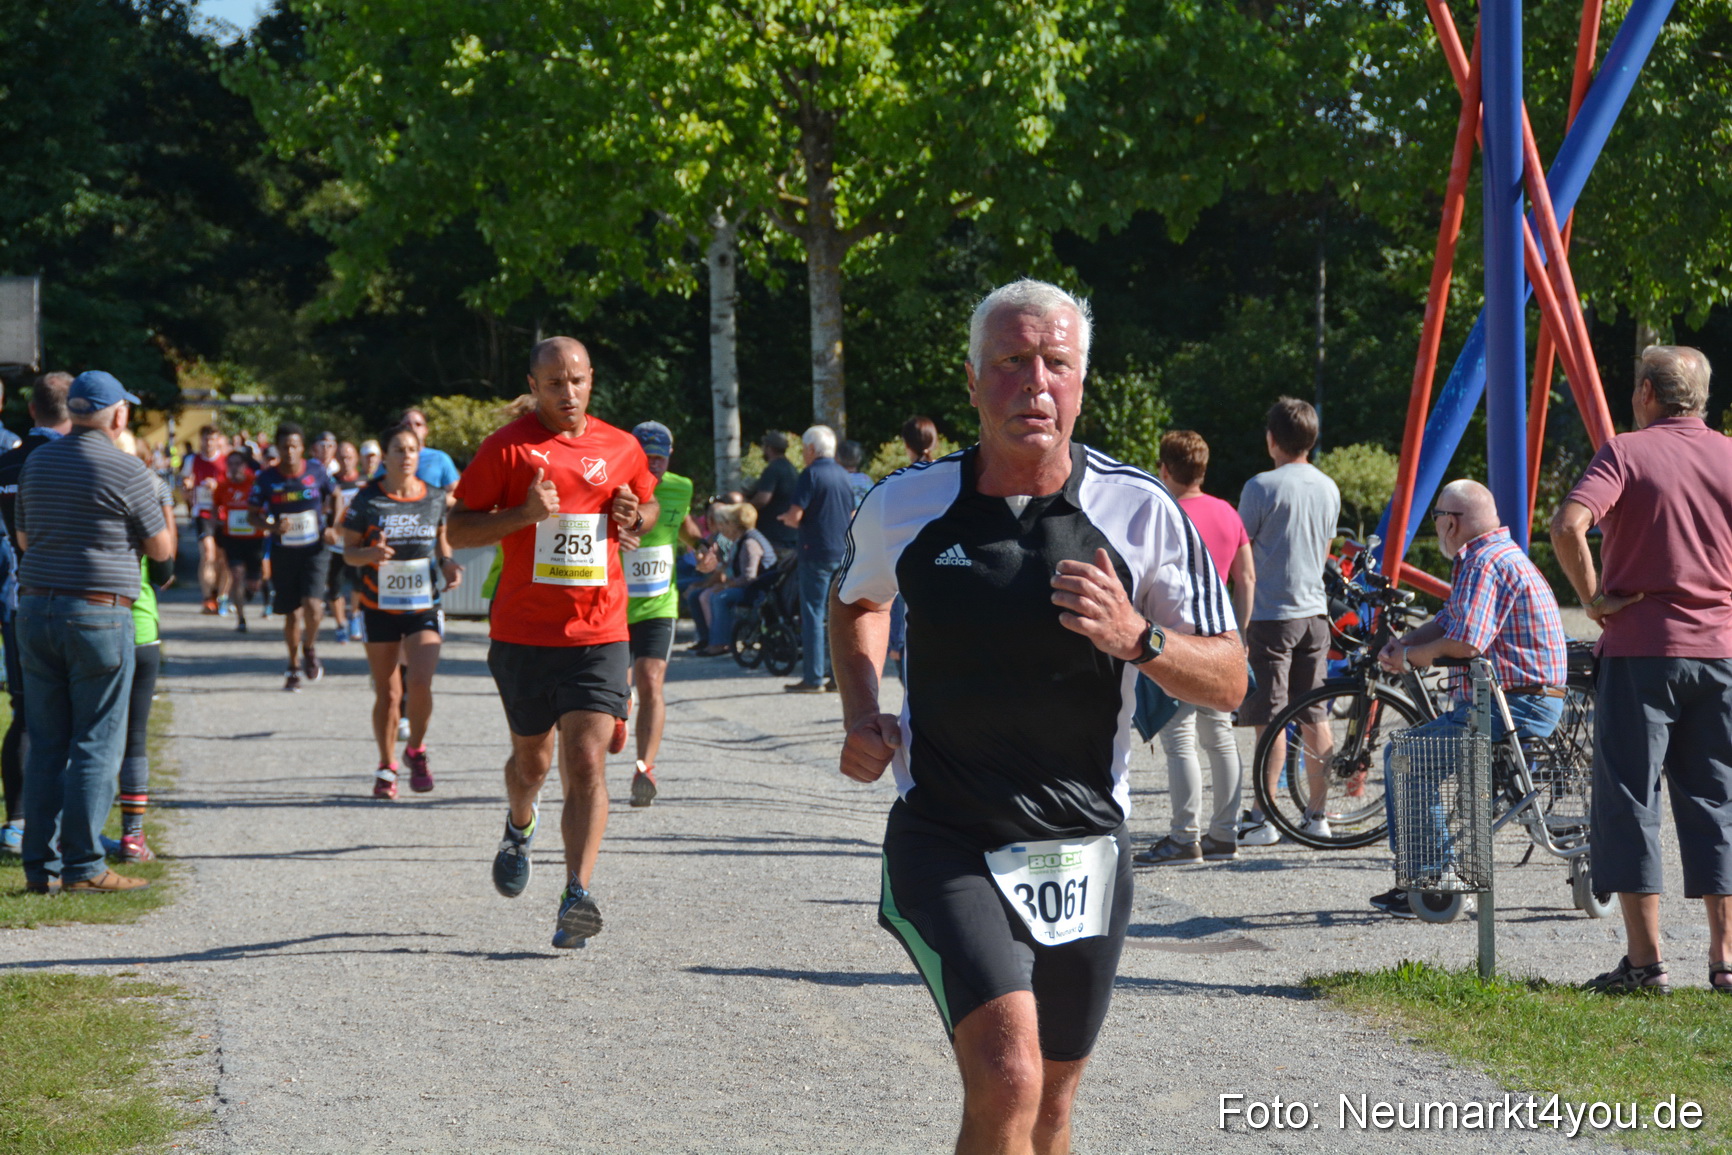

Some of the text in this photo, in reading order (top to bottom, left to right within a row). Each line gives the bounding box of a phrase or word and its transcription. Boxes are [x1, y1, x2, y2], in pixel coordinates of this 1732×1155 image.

[378, 513, 420, 527] HECK
[559, 520, 590, 528] BOCK
[383, 525, 437, 538] DESIGN
[553, 533, 592, 555] 253
[632, 559, 667, 576] 3070
[935, 556, 972, 566] adidas
[549, 566, 593, 578] Alexander
[386, 573, 423, 590] 2018
[1028, 850, 1082, 869] BOCK
[1013, 875, 1089, 923] 3061
